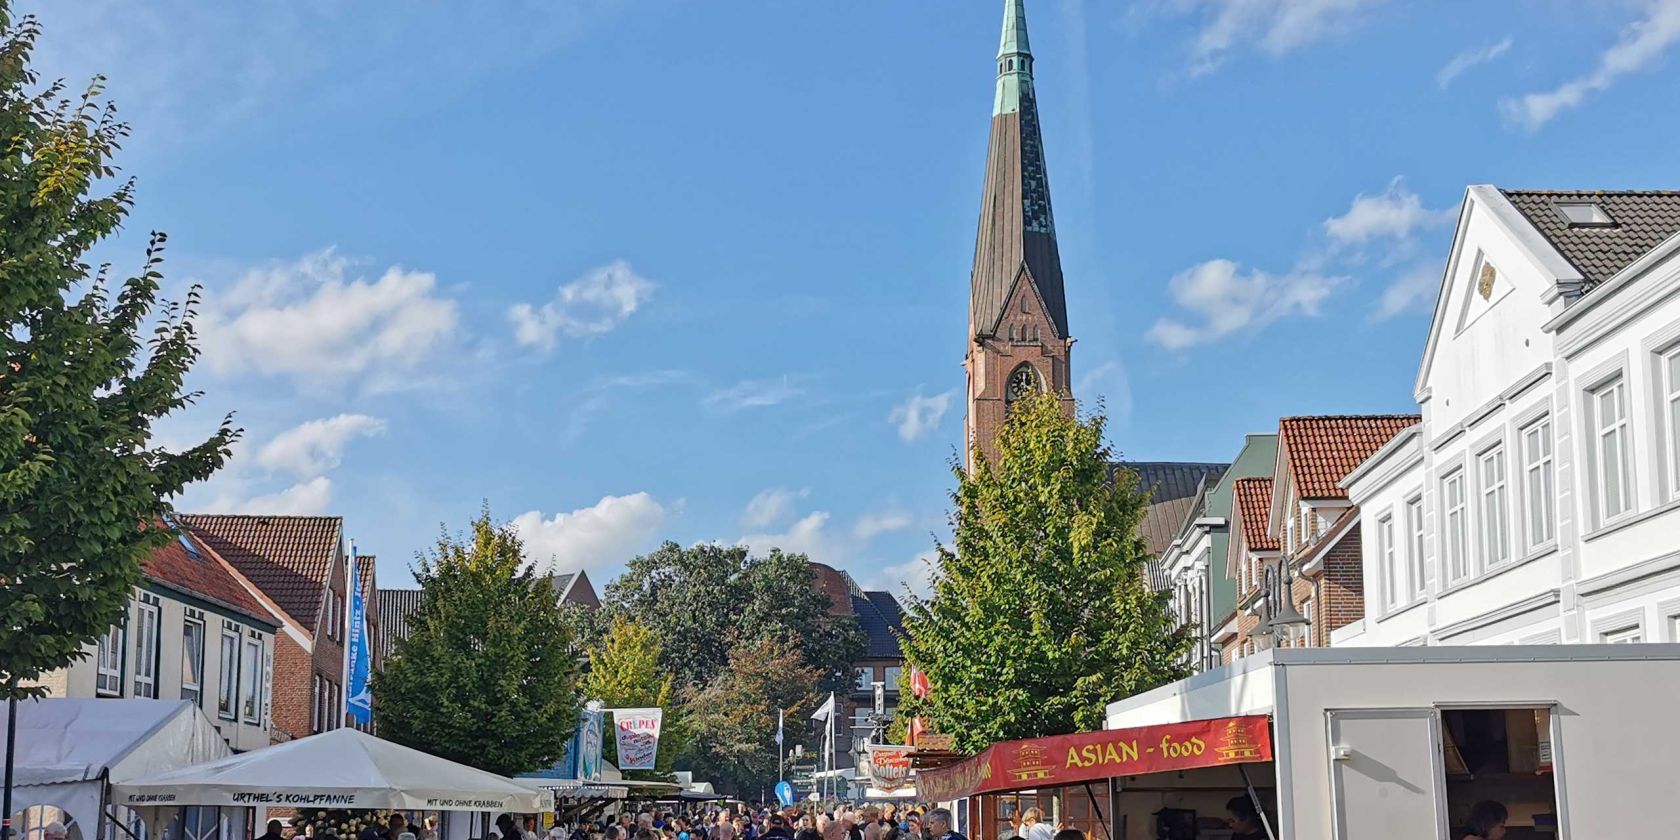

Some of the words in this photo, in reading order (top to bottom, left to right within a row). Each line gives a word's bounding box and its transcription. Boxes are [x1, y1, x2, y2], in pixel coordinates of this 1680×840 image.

[351, 612, 361, 643] Hintz
[1065, 740, 1138, 769] ASIAN
[1160, 735, 1205, 759] food
[285, 793, 355, 804] KOHLPFANNE
[427, 799, 438, 807] MIT
[440, 799, 453, 807] UND
[474, 800, 503, 808] KRABBEN
